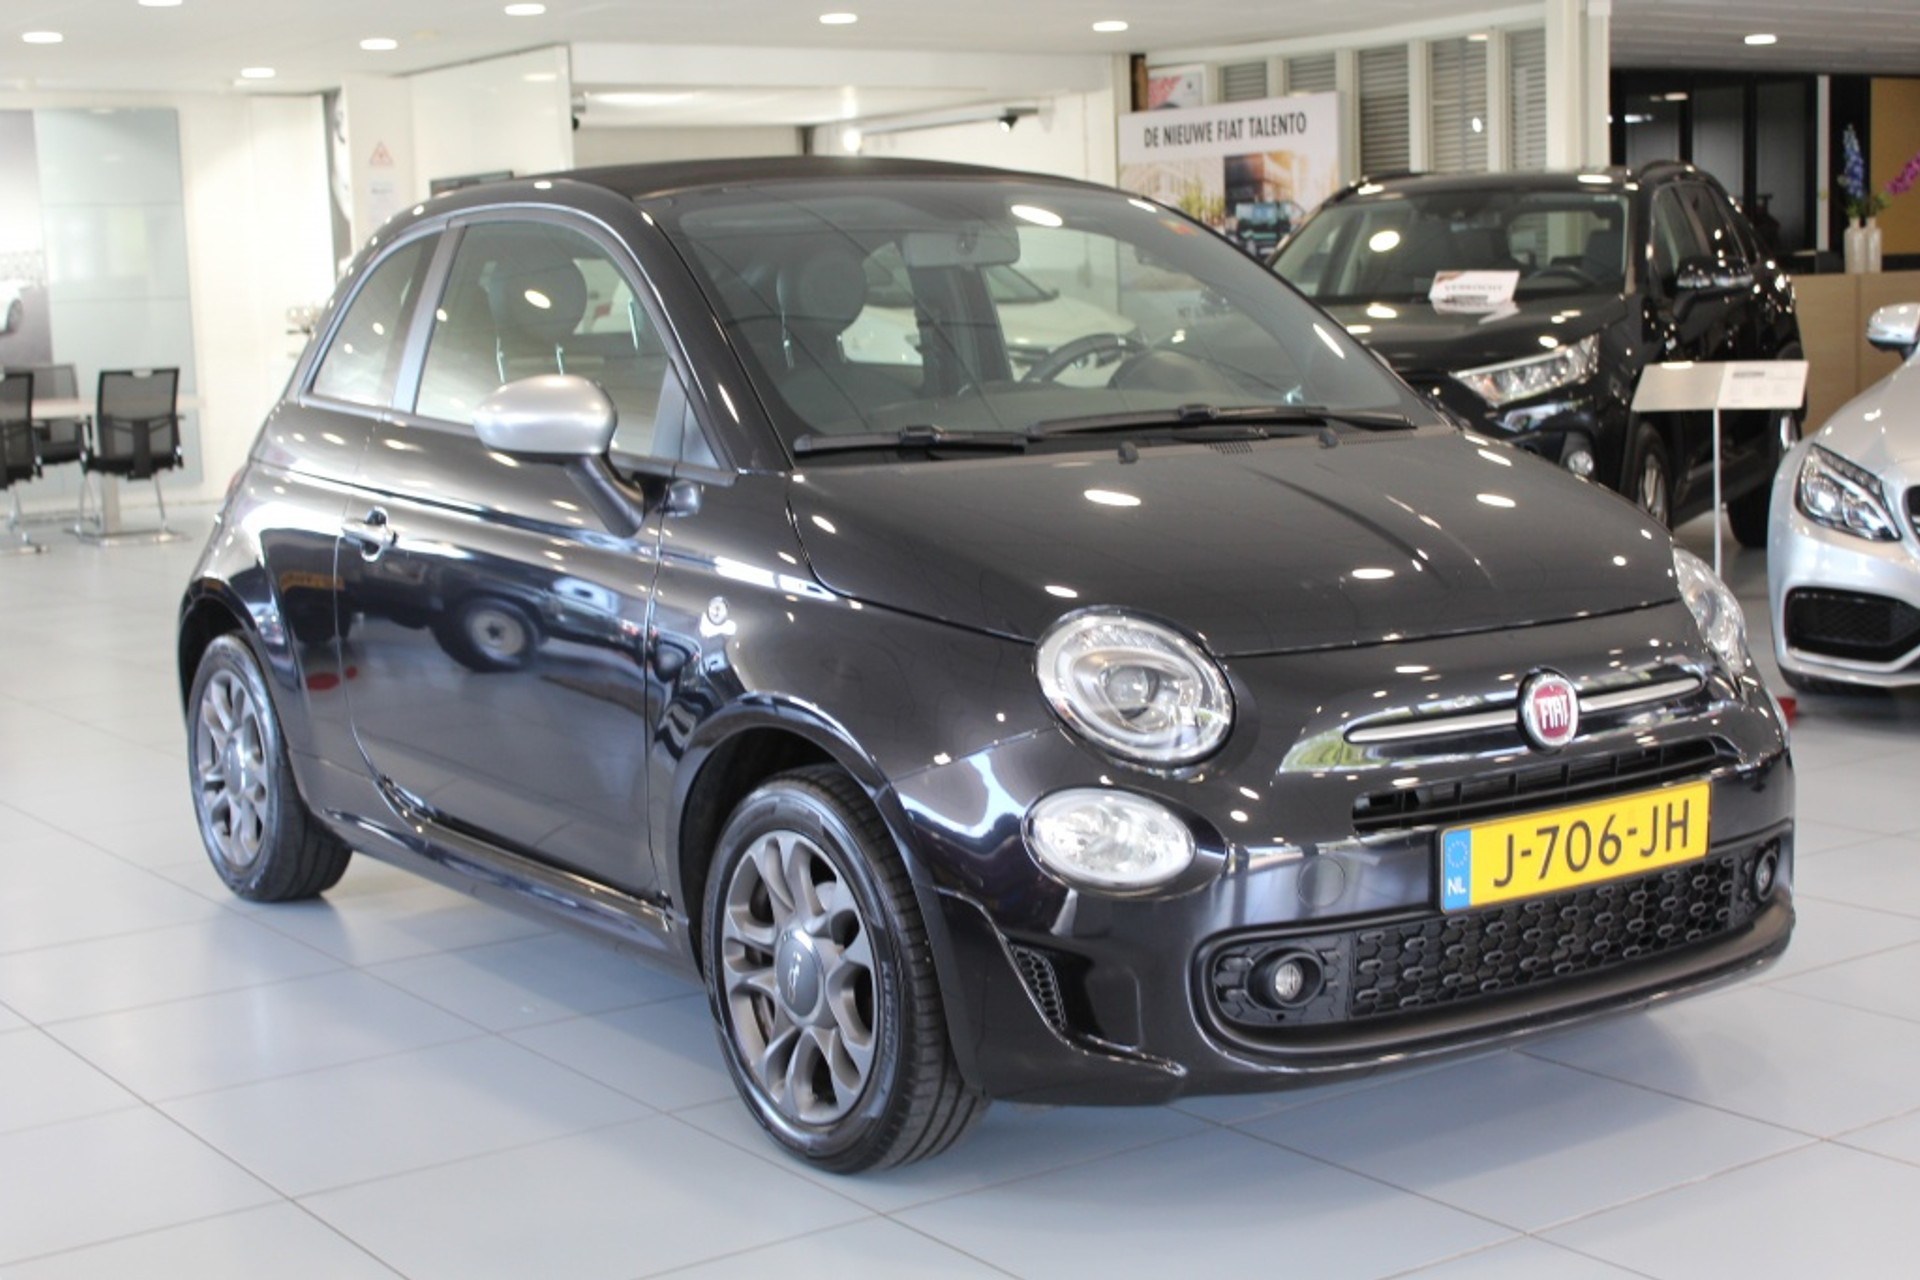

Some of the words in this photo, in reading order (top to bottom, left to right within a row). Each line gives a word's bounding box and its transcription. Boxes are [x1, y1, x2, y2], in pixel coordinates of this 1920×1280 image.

[1144, 125, 1159, 148] DE
[1163, 120, 1212, 146] NIEUWE
[1217, 118, 1243, 141] FIAT
[1249, 111, 1307, 139] TALENTO
[1535, 694, 1568, 730] FIAT
[1493, 799, 1689, 888] J-706-JH
[1448, 877, 1466, 896] NL
